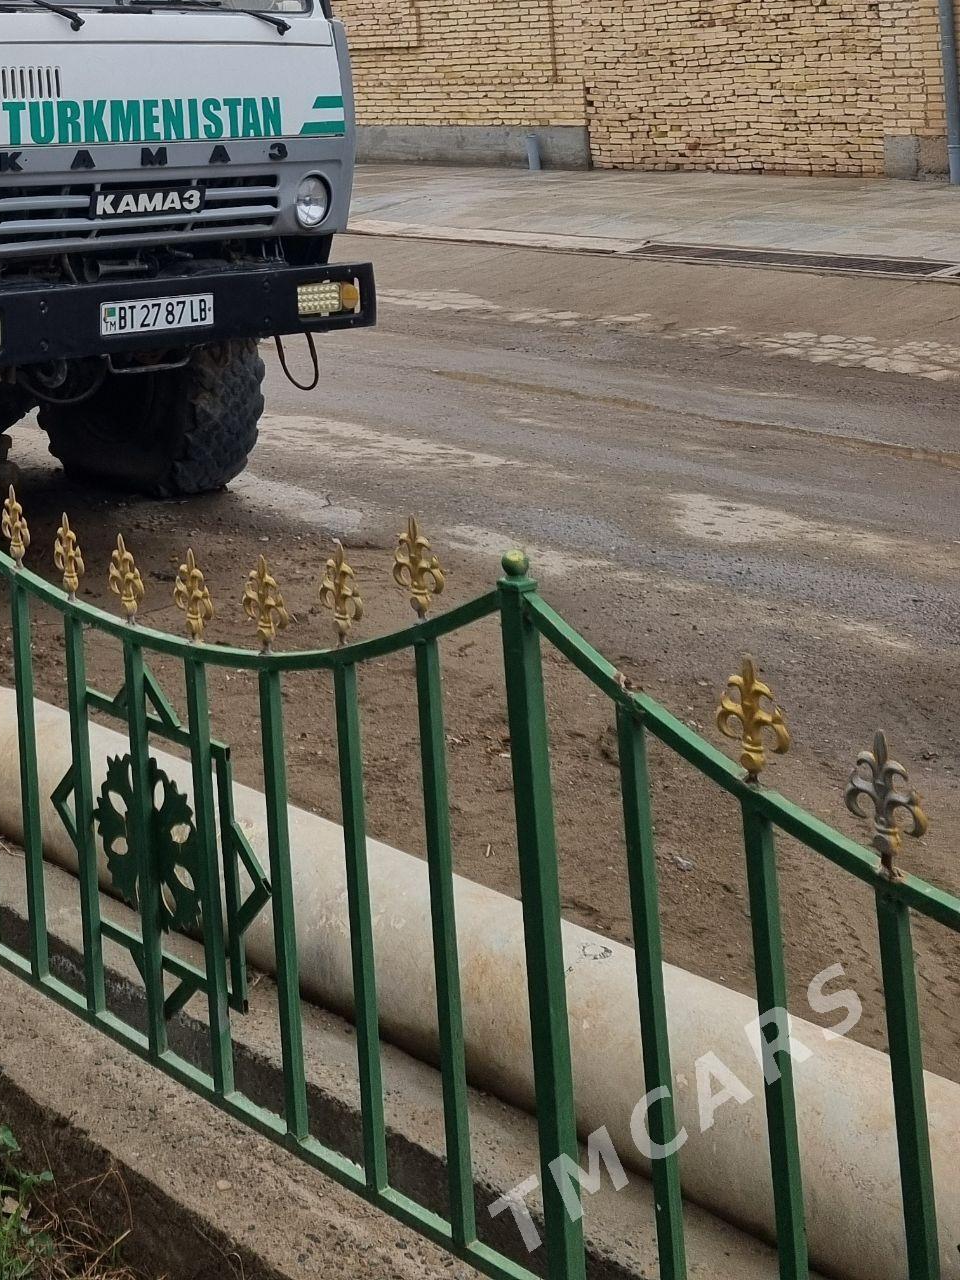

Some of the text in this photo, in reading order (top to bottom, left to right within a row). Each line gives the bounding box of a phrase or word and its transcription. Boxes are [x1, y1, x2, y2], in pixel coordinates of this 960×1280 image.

[2, 96, 282, 145] TURKMENISTAN
[95, 190, 201, 216] КАМАЗ
[140, 303, 161, 328] 27
[165, 301, 186, 324] 87
[190, 299, 207, 322] LB
